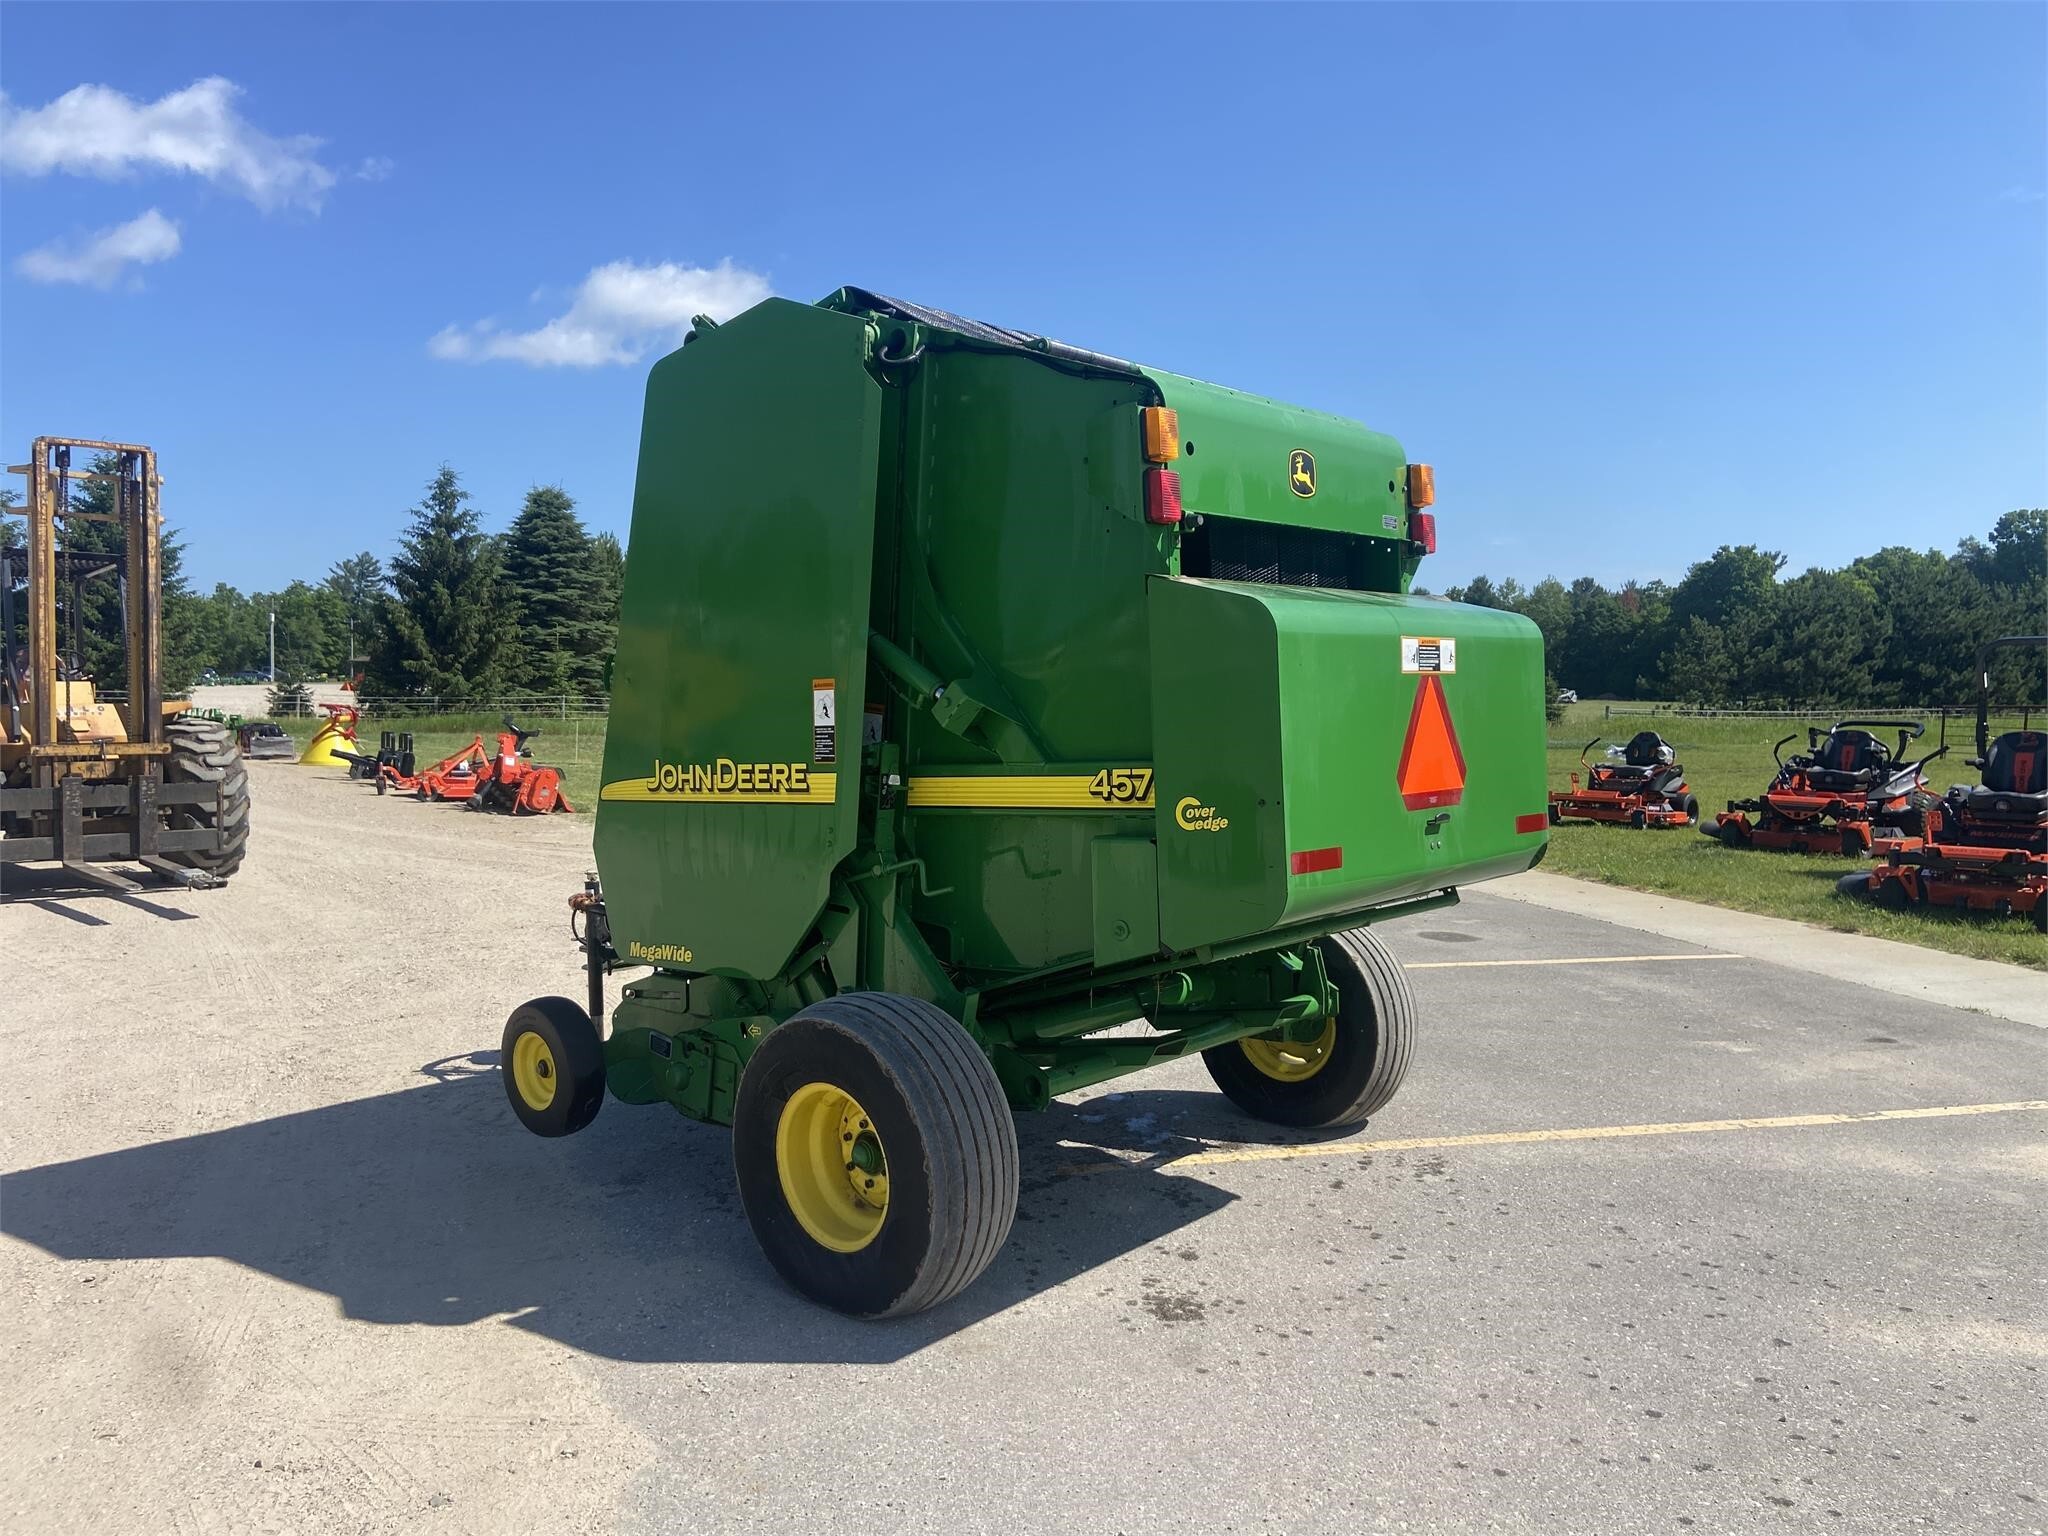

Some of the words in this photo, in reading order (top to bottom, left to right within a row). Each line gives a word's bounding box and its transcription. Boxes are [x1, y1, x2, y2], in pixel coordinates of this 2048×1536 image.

[647, 759, 713, 791] JOHN
[716, 758, 809, 791] DEERE
[1089, 768, 1153, 801] 457
[1194, 817, 1229, 832] edge
[629, 941, 693, 963] MegaWide
